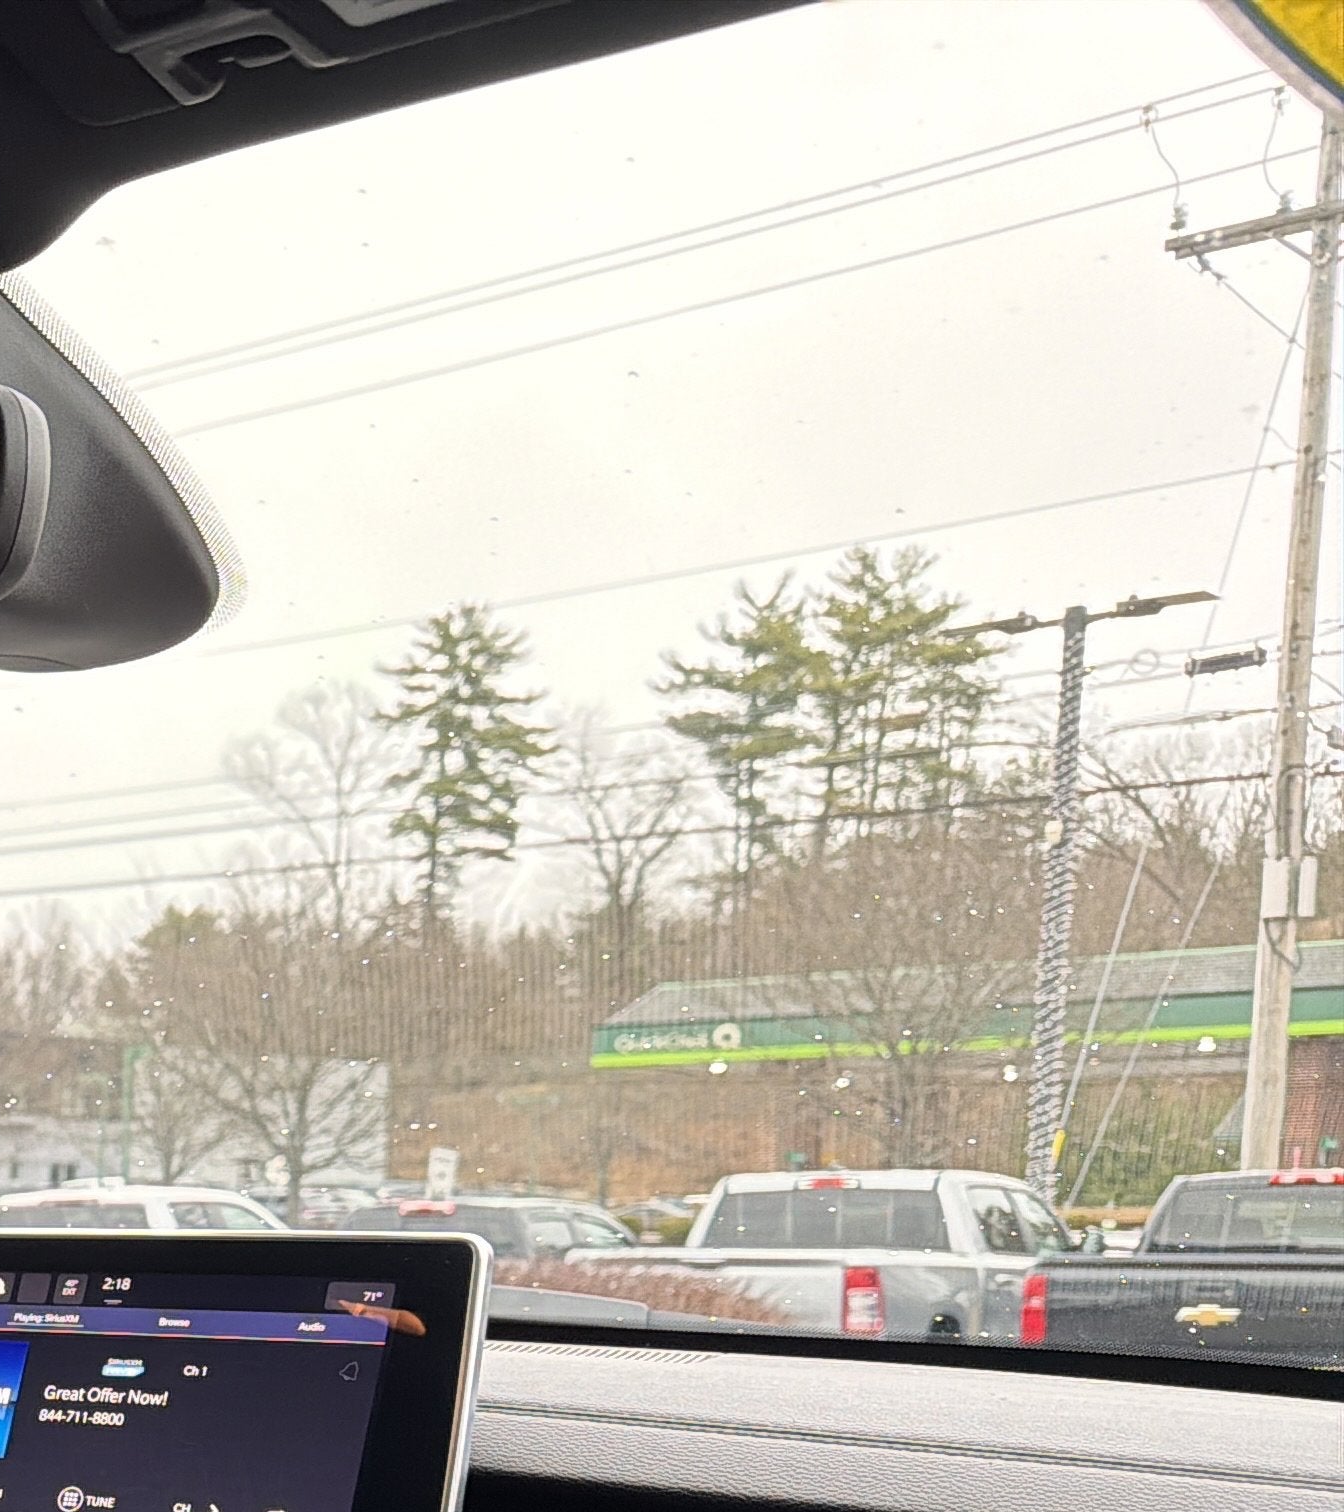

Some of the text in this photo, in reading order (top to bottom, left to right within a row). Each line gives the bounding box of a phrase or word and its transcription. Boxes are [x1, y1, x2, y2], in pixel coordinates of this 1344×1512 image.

[101, 1277, 132, 1292] 2:18
[44, 1313, 80, 1324] SiriusXM
[158, 1317, 191, 1328] Browse
[297, 1321, 327, 1333] Audio
[182, 1364, 199, 1377] Ch
[43, 1384, 170, 1407] Great Offer Now!
[38, 1408, 125, 1428] 844-711-8800
[85, 1494, 116, 1509] TUNE
